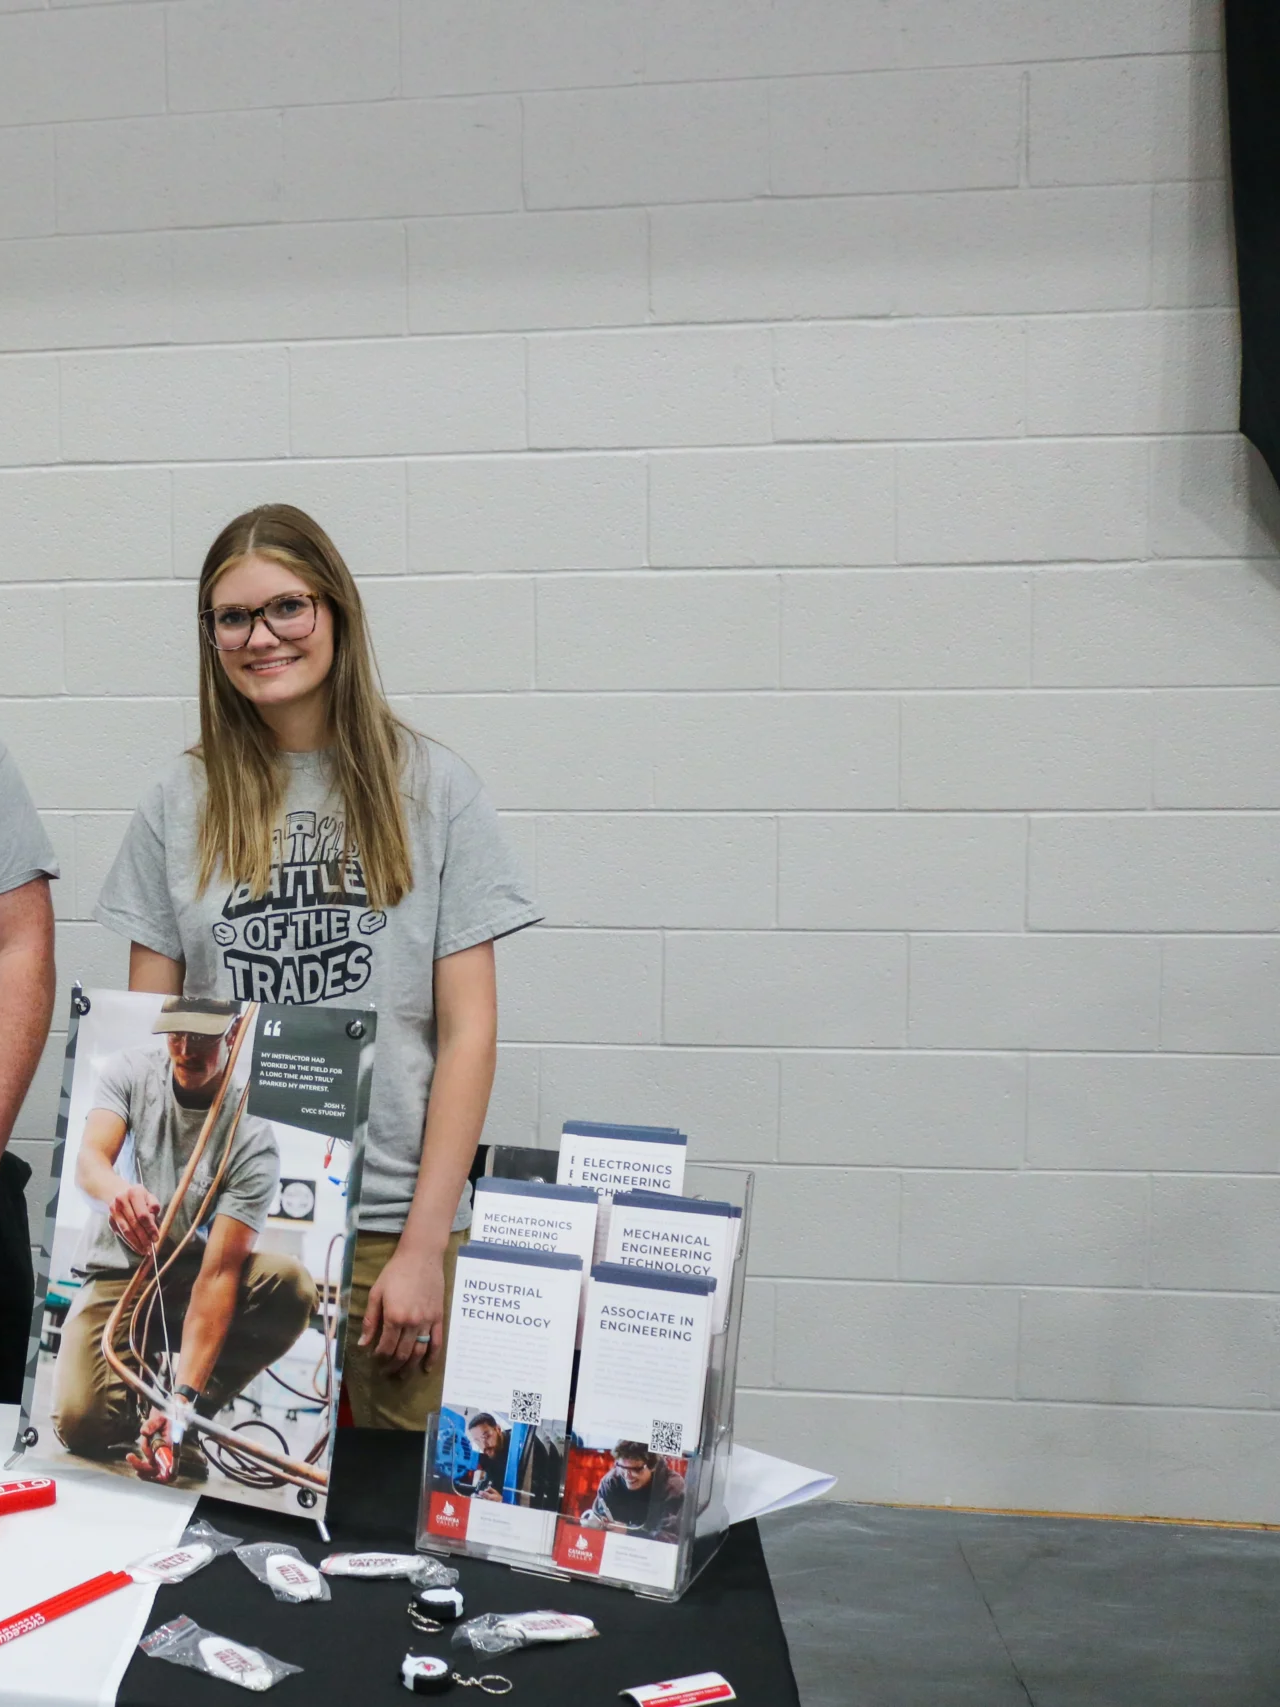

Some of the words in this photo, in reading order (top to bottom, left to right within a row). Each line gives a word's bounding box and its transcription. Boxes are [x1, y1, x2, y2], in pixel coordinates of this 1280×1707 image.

[244, 912, 289, 951] OF
[290, 908, 350, 949] THE
[224, 941, 372, 1005] TRADES
[260, 1061, 288, 1070] WORKED
[271, 1053, 310, 1063] INSTRUCTOR
[311, 1056, 325, 1064] HAD
[259, 1079, 287, 1088] SPARKED
[298, 1084, 329, 1092] INTEREST.
[314, 1076, 334, 1084] TRULY
[301, 1107, 317, 1115] CVCC
[318, 1109, 345, 1117] STUDENT
[324, 1102, 340, 1110] JOSH
[583, 1157, 673, 1175] ELECTRONICS
[582, 1171, 671, 1189] ENGINEERING
[484, 1213, 572, 1230] MECHATRONICS
[483, 1224, 559, 1241] ENGINEERING
[623, 1228, 711, 1247] MECHANICAL
[482, 1236, 557, 1252] TECHNOLOGY
[621, 1242, 712, 1261] ENGINEERING
[620, 1256, 711, 1276] TECHNOLOGY
[464, 1279, 543, 1298] INDUSTRIAL
[462, 1293, 521, 1310] SYSTEMS
[461, 1307, 551, 1328] TECHNOLOGY
[601, 1305, 675, 1324] ASSOCIATE
[680, 1316, 694, 1327] IN
[600, 1320, 692, 1342] ENGINEERING
[436, 1514, 460, 1523] CATAWBA
[568, 1548, 593, 1558] CATAWBA
